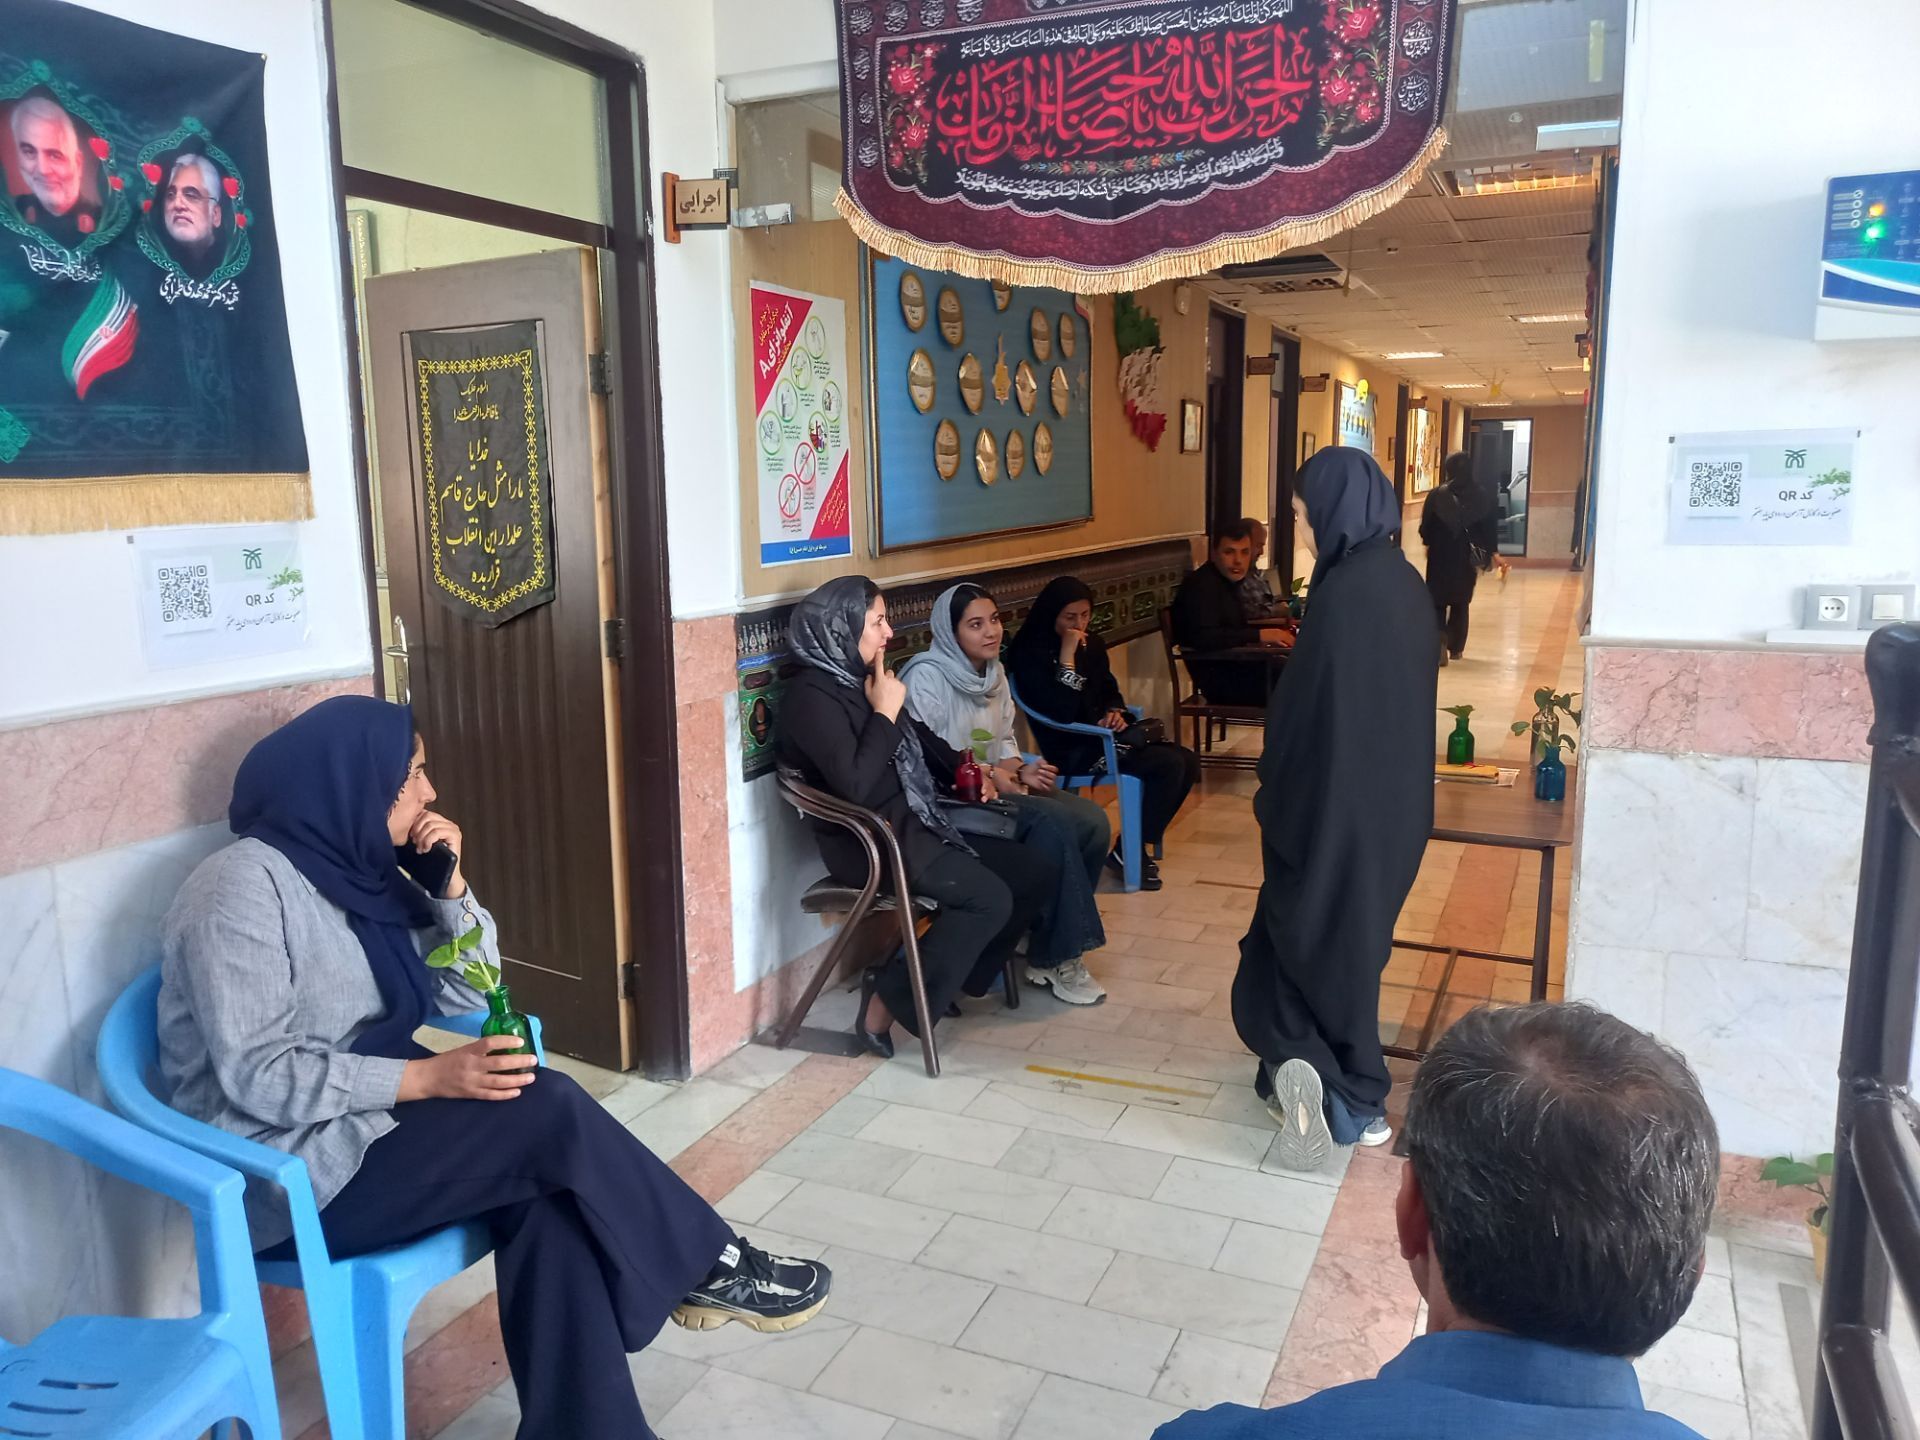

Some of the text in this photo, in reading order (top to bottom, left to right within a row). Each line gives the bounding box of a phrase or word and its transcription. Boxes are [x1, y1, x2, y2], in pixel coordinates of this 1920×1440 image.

[679, 187, 721, 214] اجرایی
[208, 279, 231, 308] دکتر
[224, 282, 240, 311] شهید
[759, 300, 794, 380] آنفلوانزای A
[469, 436, 489, 471] خدایا
[440, 474, 463, 525] قاسم
[463, 481, 488, 512] حاج
[487, 459, 508, 509] مثل
[1778, 490, 1814, 502] کد QR
[445, 517, 523, 555] علمدار این انقلاب
[245, 592, 275, 607] کد QR
